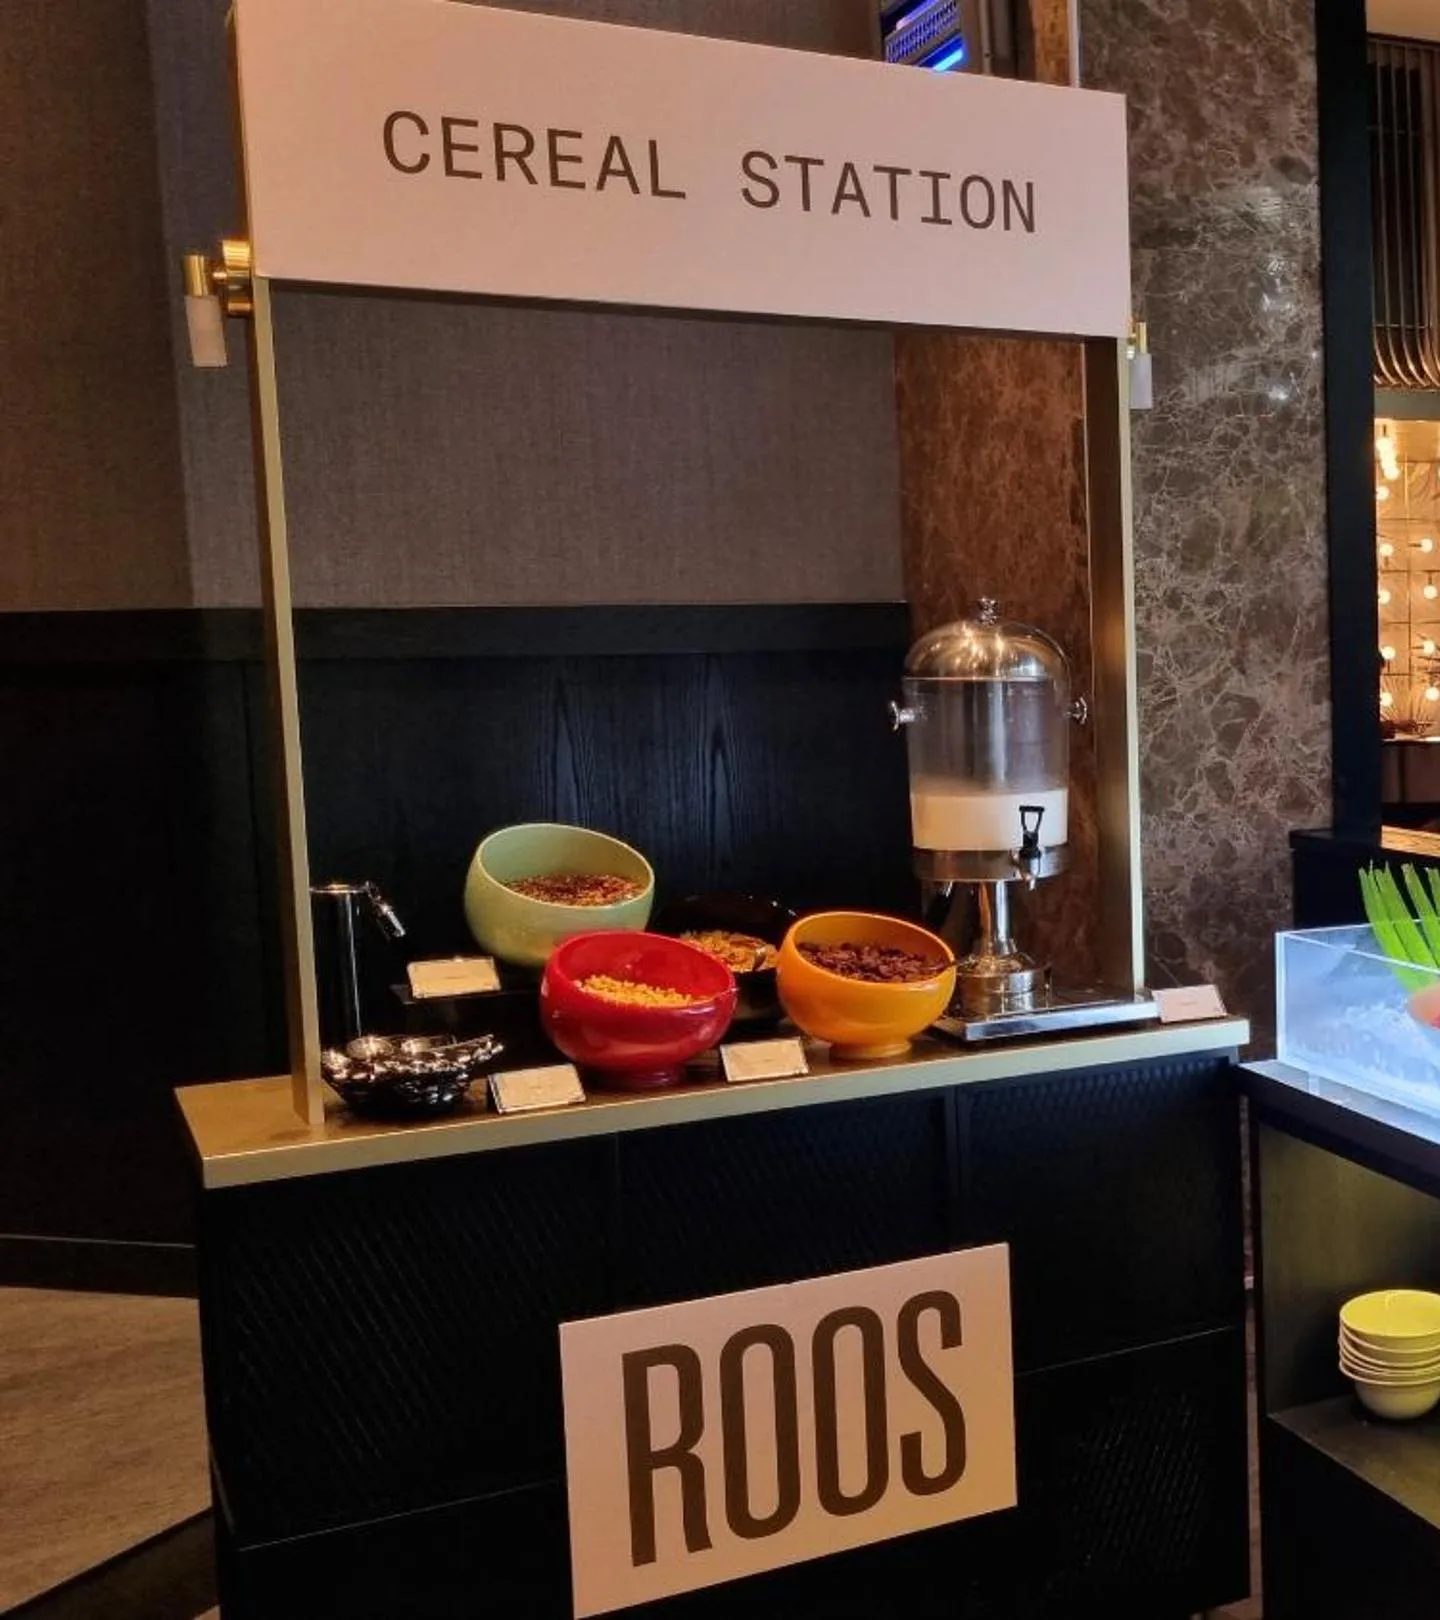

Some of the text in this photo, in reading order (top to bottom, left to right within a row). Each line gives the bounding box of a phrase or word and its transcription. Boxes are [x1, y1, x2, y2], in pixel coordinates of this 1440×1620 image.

[383, 110, 1036, 233] CEREAL STATION
[622, 1290, 966, 1567] ROOS
